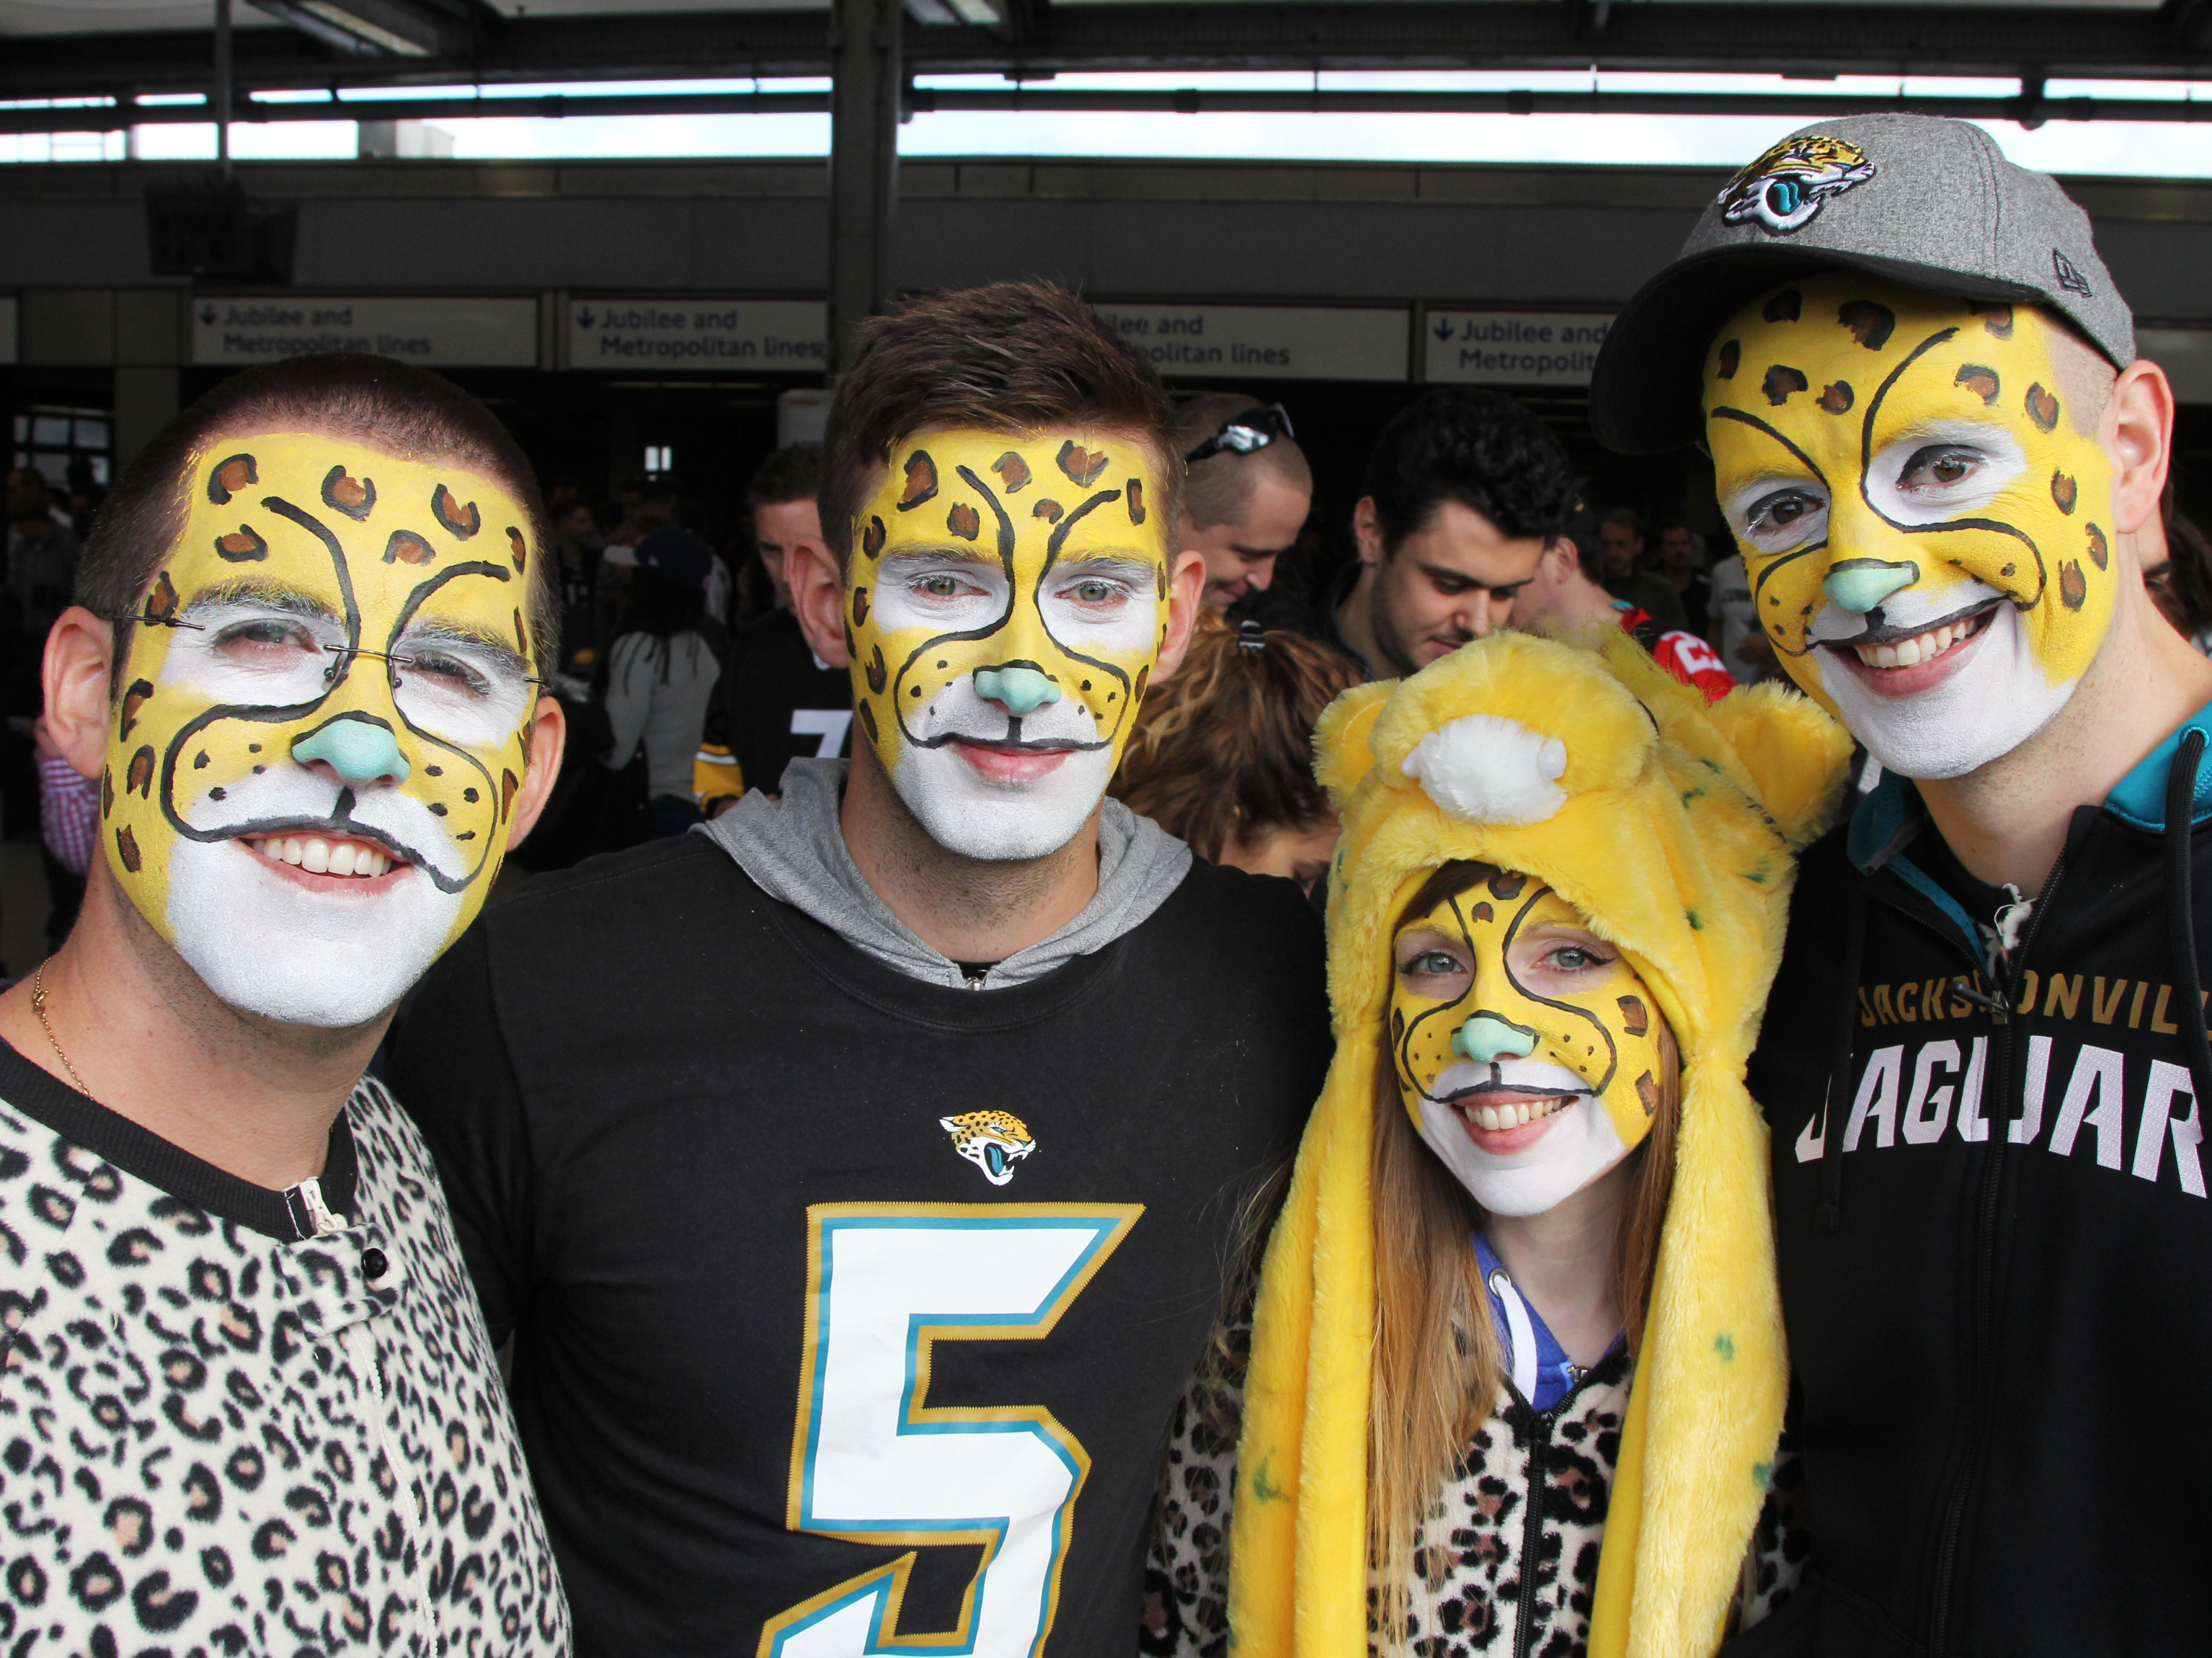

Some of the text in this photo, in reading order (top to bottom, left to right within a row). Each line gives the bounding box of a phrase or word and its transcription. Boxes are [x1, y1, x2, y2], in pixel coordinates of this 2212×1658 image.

[225, 306, 352, 326] Jubilee and
[602, 308, 737, 330] Jubilee and
[1156, 313, 1204, 335] and
[1460, 321, 1608, 344] Jubilee and
[223, 334, 431, 355] Metropolitan lines
[600, 335, 826, 360] Metropolitan lines
[1230, 342, 1291, 365] lines
[1459, 347, 1595, 376] Metropolit
[755, 1201, 1147, 1658] 5
